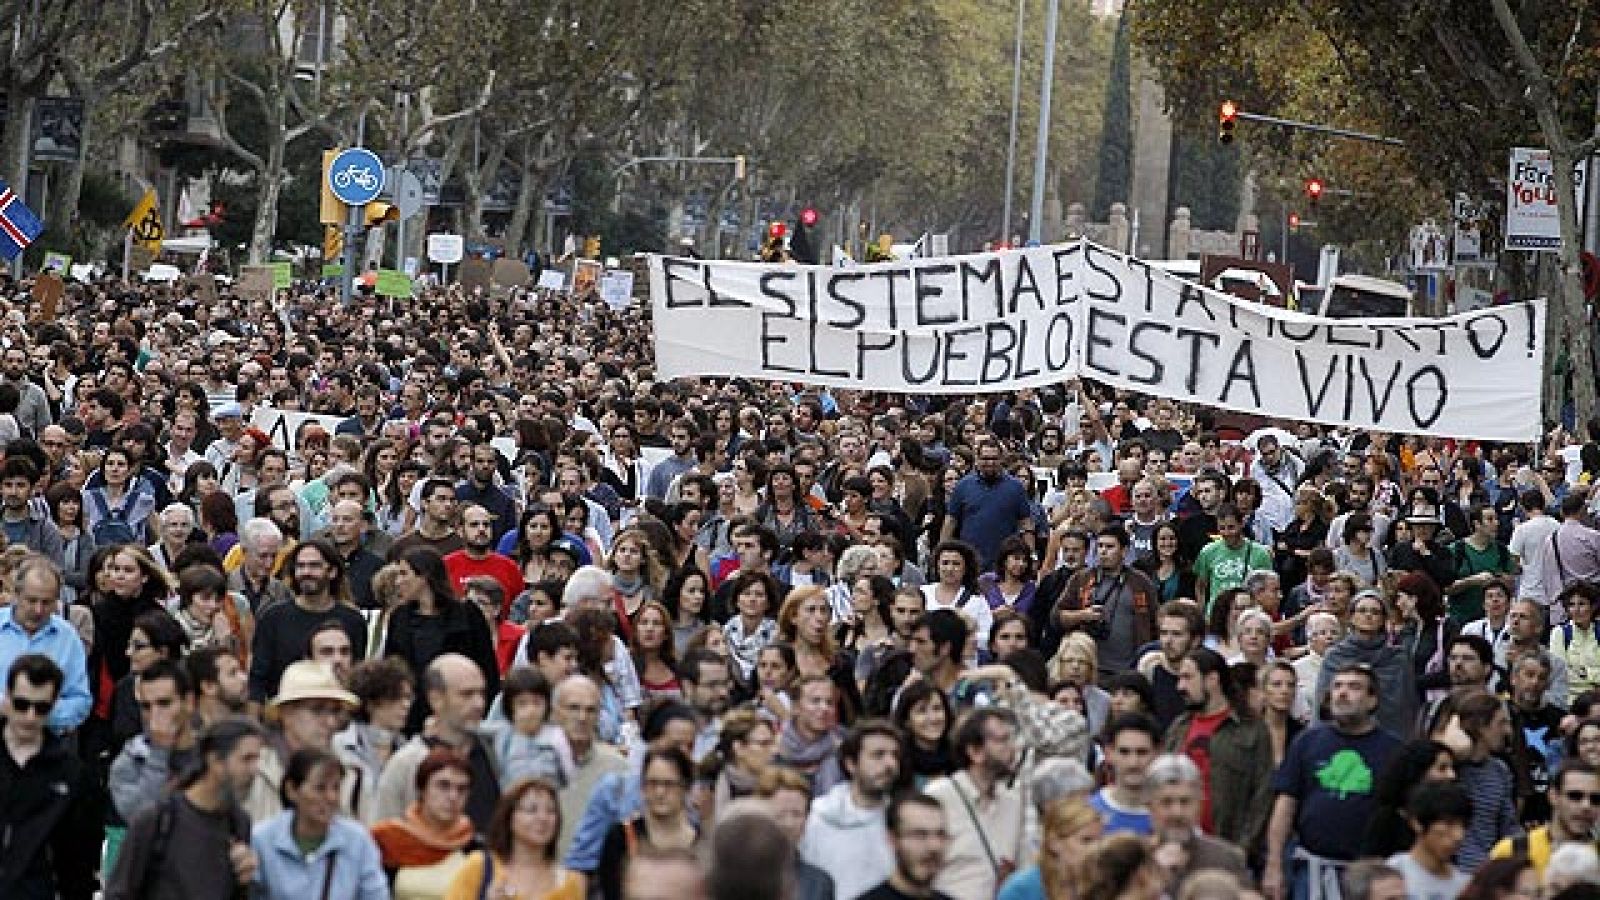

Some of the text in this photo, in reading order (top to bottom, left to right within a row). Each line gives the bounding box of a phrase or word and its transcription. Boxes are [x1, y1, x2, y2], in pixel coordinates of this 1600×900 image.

[662, 257, 753, 309] EL
[759, 254, 1045, 330] SISTEMA
[761, 311, 850, 379] EL
[857, 311, 1074, 387] PUEBLO
[1295, 349, 1449, 429] VIVO
